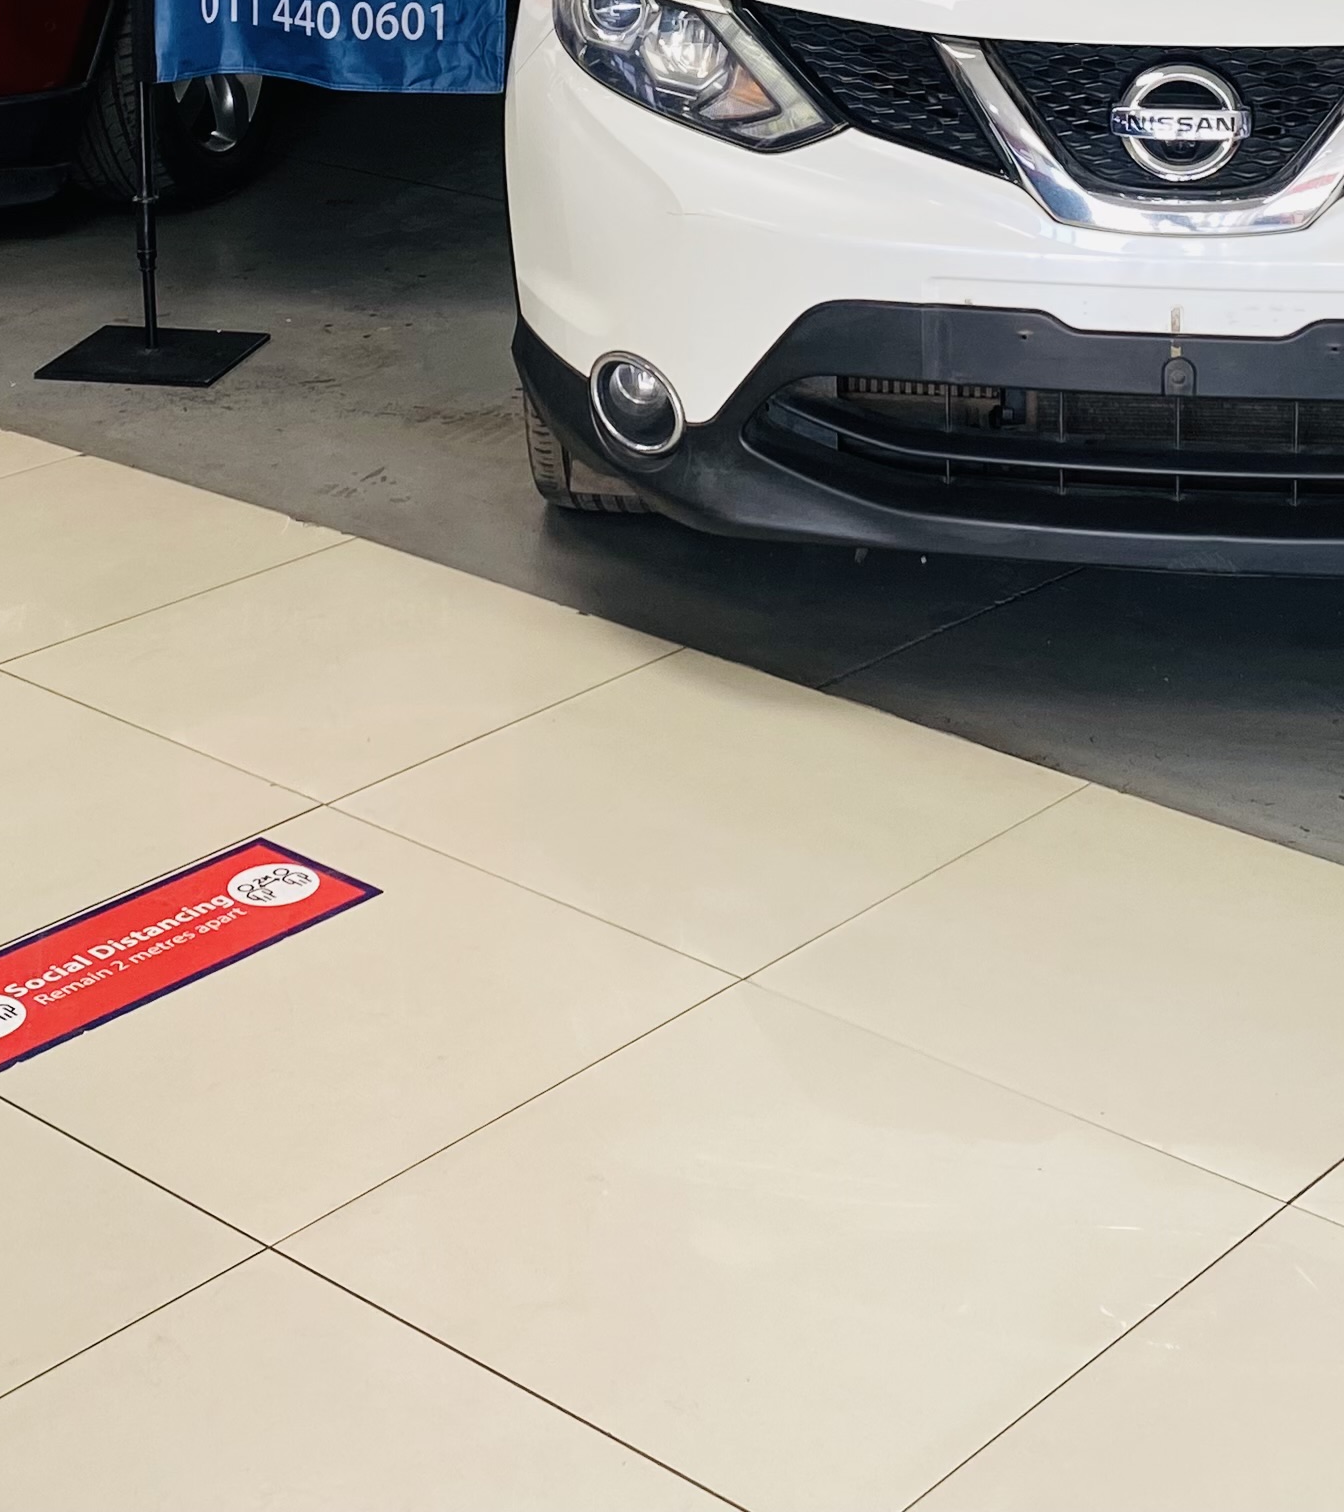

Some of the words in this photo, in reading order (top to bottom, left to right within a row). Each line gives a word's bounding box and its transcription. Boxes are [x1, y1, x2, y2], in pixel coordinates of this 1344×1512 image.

[351, 2, 445, 41] 0601
[1125, 113, 1236, 133] NISSAN
[4, 954, 93, 998] Social
[87, 894, 235, 961] Distancing
[33, 967, 114, 1006] Remain
[110, 960, 131, 972] 2
[128, 930, 196, 965] metres
[194, 906, 249, 932] apart
